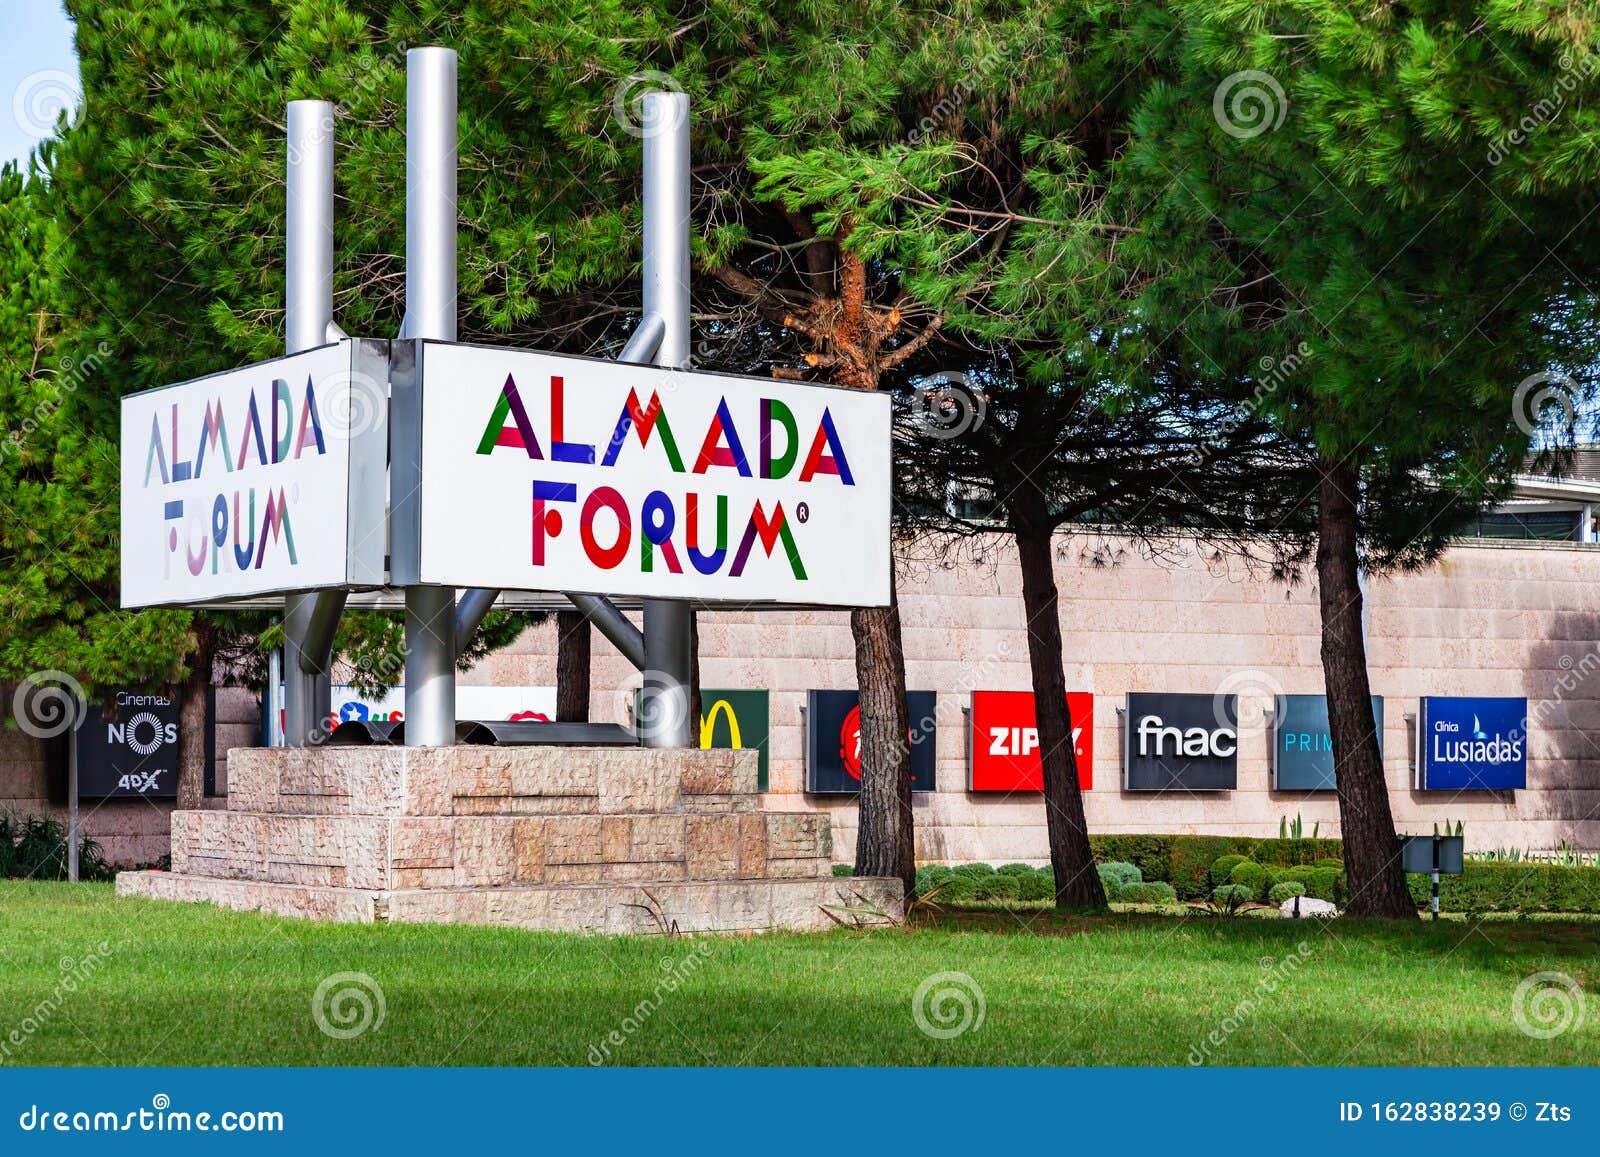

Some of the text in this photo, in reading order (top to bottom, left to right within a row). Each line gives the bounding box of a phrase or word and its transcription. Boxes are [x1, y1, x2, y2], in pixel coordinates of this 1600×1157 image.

[143, 372, 326, 488] ALMADA
[476, 372, 855, 486] ALMADA
[164, 484, 298, 580] FORUM
[532, 480, 808, 580] FORUM
[116, 691, 170, 706] Cinemas
[107, 712, 177, 755] NOS
[1137, 715, 1237, 758] fnac
[1285, 733, 1333, 752] PRIM
